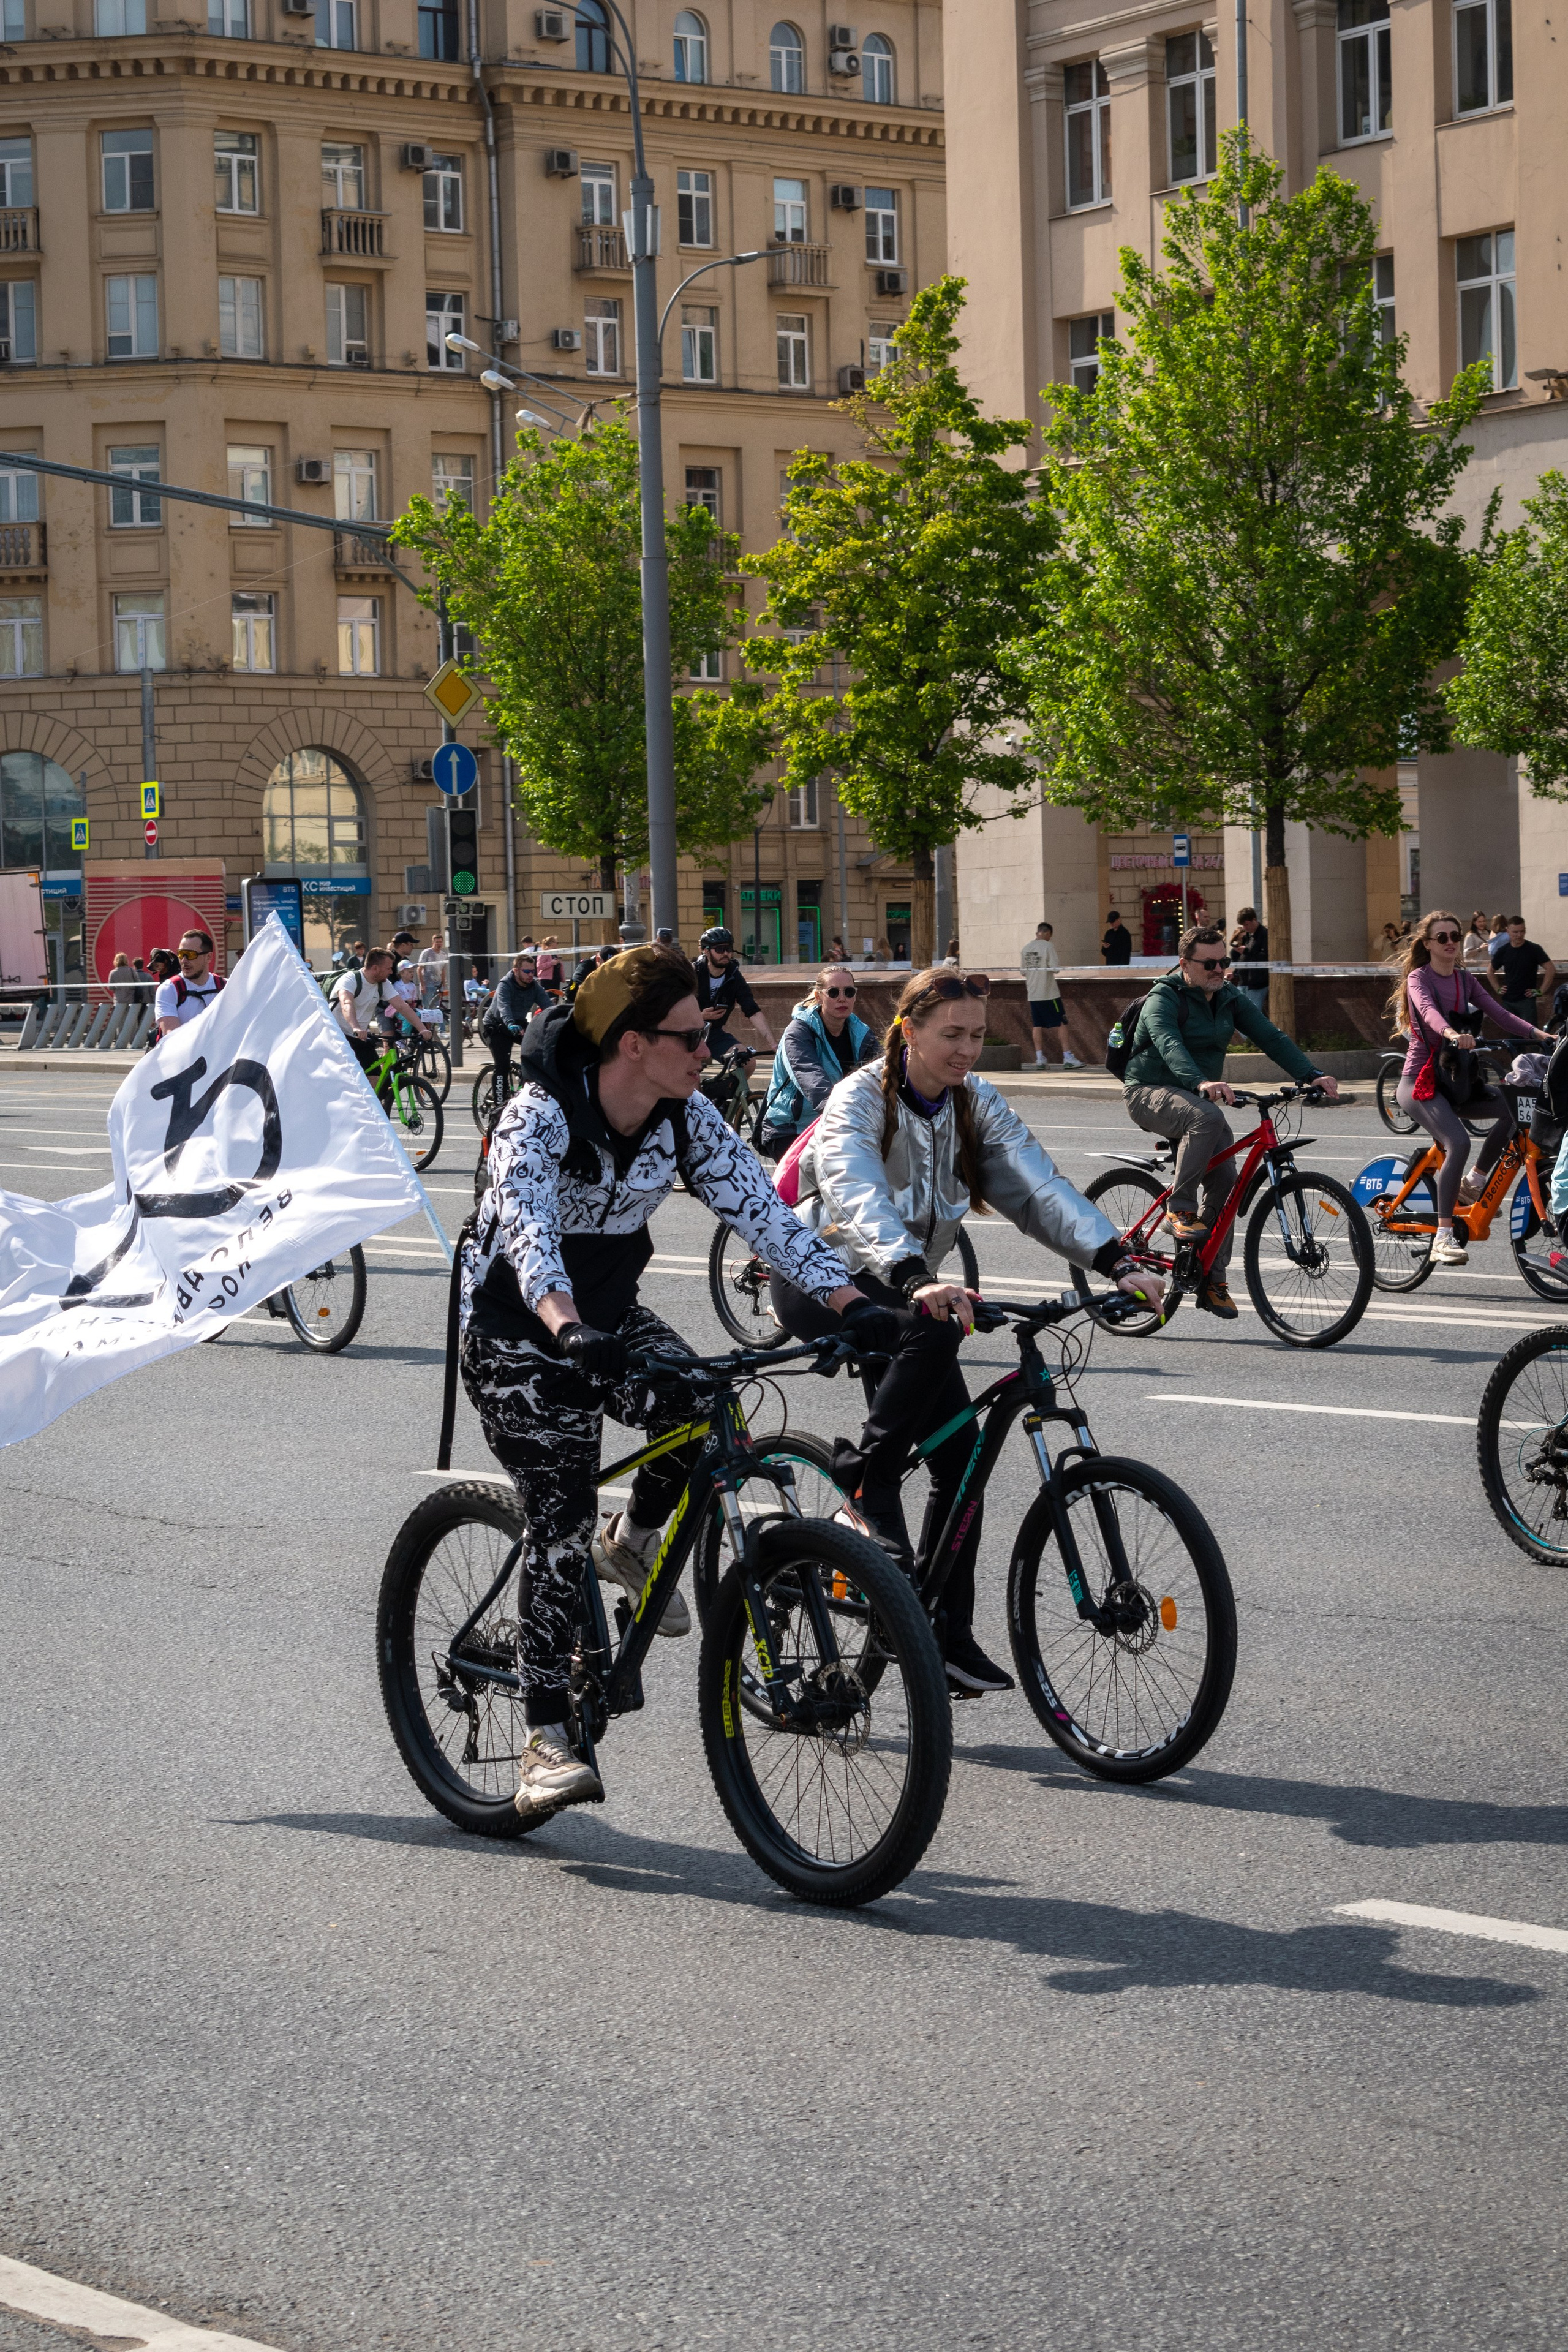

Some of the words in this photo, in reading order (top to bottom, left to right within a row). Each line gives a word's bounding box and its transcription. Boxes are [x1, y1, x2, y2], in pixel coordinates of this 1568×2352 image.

[1111, 853, 1168, 870] ЦВЕТОЧНЫЙ
[303, 881, 318, 892] КС
[741, 891, 781, 901] АПЕКИ
[552, 897, 603, 914] СТОП
[1519, 1110, 1531, 1121] 56
[1366, 1178, 1382, 1190] ВТБ
[1485, 1161, 1511, 1202] Велоб
[1520, 1196, 1531, 1205] ВТБ
[951, 1501, 978, 1551] STERN
[635, 1482, 689, 1623] JAMIS
[1041, 1681, 1057, 1708] 27.5
